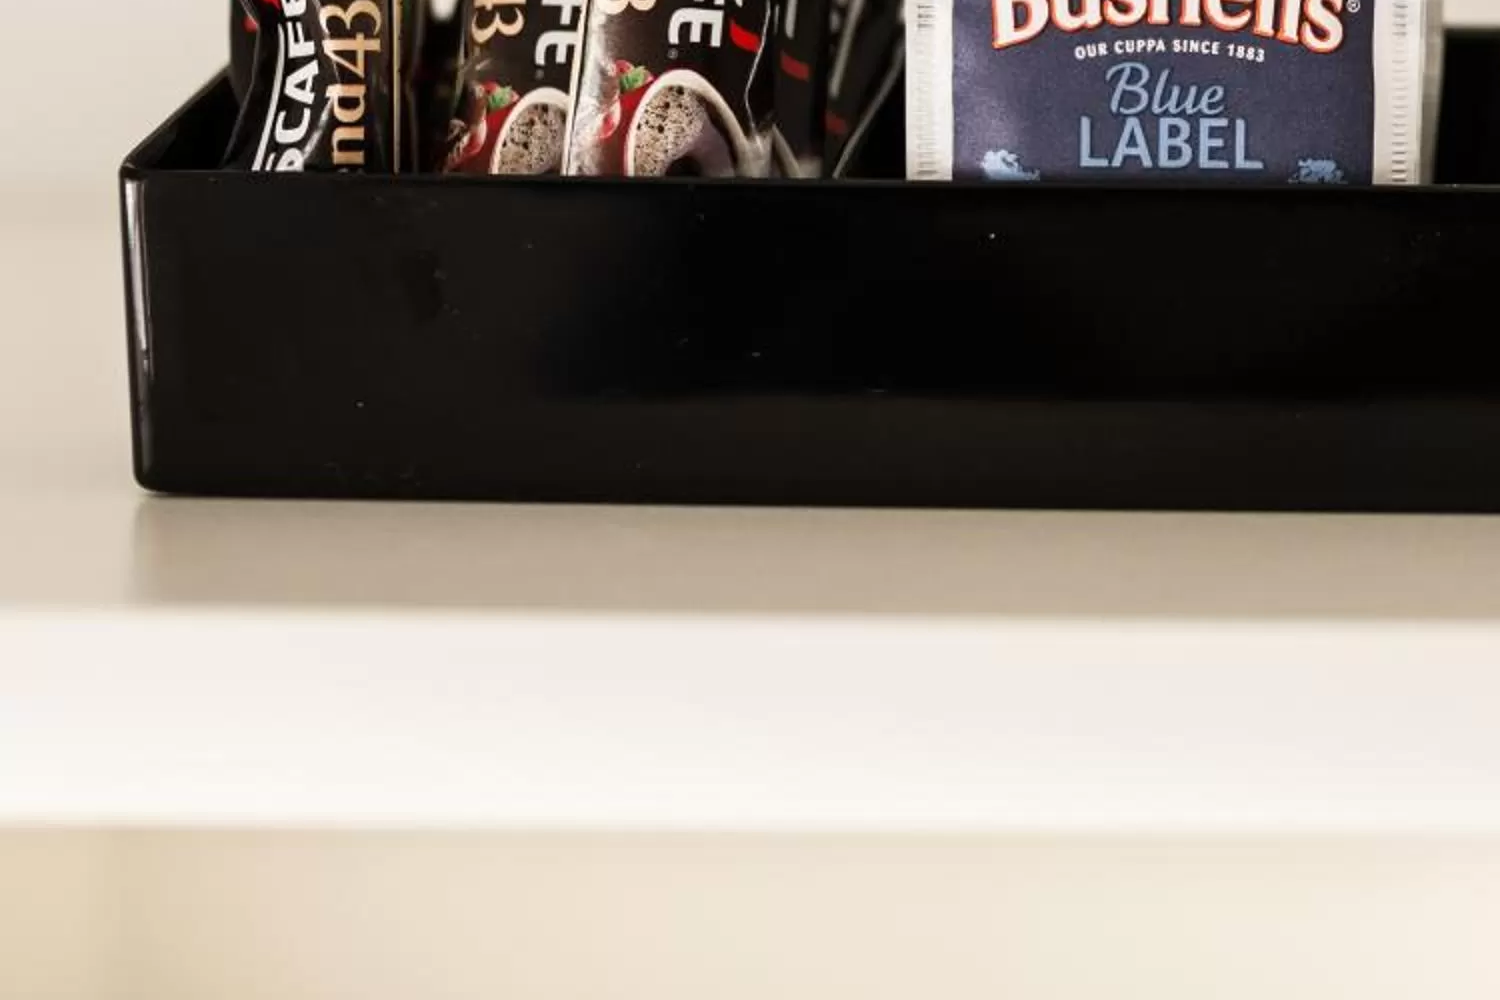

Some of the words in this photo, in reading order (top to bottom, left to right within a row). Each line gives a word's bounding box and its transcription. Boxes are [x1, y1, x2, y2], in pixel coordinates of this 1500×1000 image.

[1074, 43, 1108, 60] OUR
[1114, 39, 1166, 54] CUPPA
[1172, 39, 1220, 55] SINCE
[1226, 44, 1265, 63] 1883
[1104, 61, 1226, 115] Blue
[1079, 115, 1265, 169] LABEL
